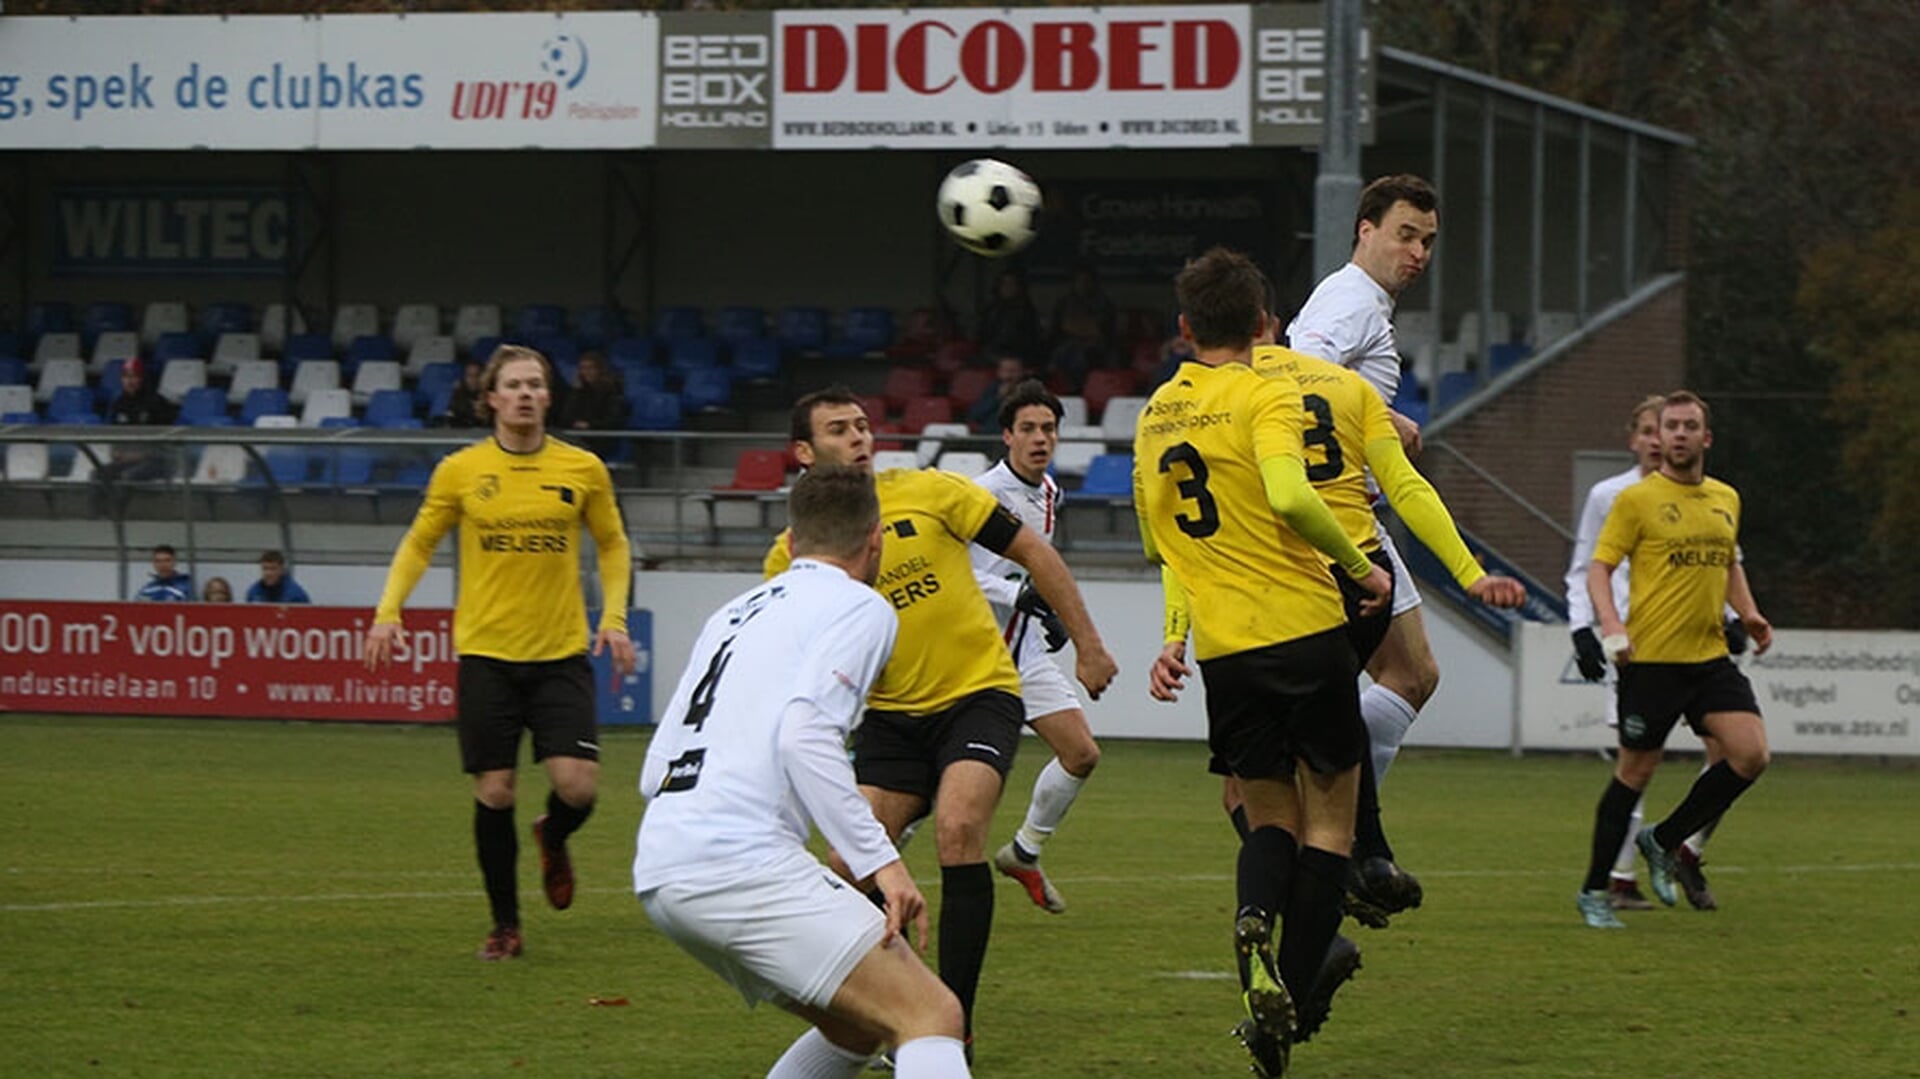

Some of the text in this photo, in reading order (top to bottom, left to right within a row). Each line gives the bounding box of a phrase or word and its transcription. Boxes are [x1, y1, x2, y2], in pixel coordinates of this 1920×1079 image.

[664, 35, 768, 66] BED
[783, 19, 1242, 95] DICOBED
[1258, 29, 1369, 62] BE
[46, 63, 154, 120] spek
[176, 62, 228, 109] de
[248, 62, 424, 109] clubkas
[664, 74, 766, 105] BOX
[662, 112, 768, 127] HOLLAND
[61, 198, 289, 260] WILTEC
[1302, 393, 1345, 482] 3
[1159, 441, 1220, 539] 3
[0, 612, 50, 654] 00
[128, 614, 235, 669] volop
[0, 671, 455, 712] ndustrielaan 10 www.livingfo
[682, 633, 738, 733] 4
[1768, 681, 1837, 707] Veghel
